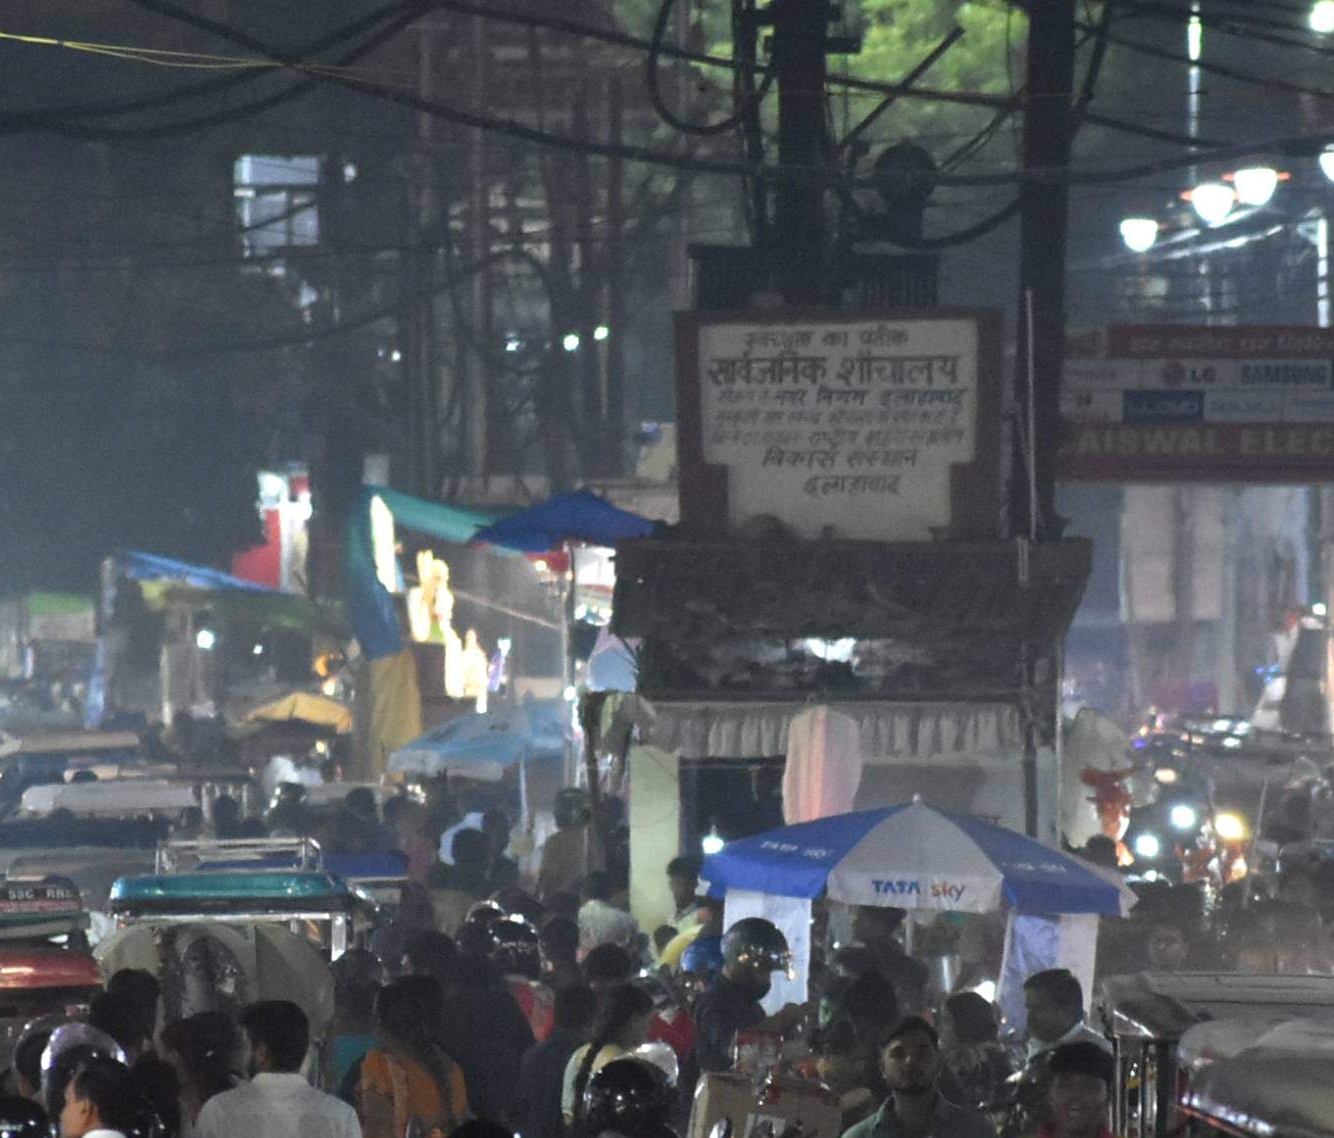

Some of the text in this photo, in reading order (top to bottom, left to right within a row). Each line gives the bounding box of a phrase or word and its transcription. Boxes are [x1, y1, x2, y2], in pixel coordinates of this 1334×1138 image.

[1190, 365, 1217, 384] LG
[1240, 364, 1327, 386] SAMSUNG
[1067, 429, 1226, 456] AISWAL
[8, 889, 34, 900] SSC
[872, 880, 966, 901] TATA sky
